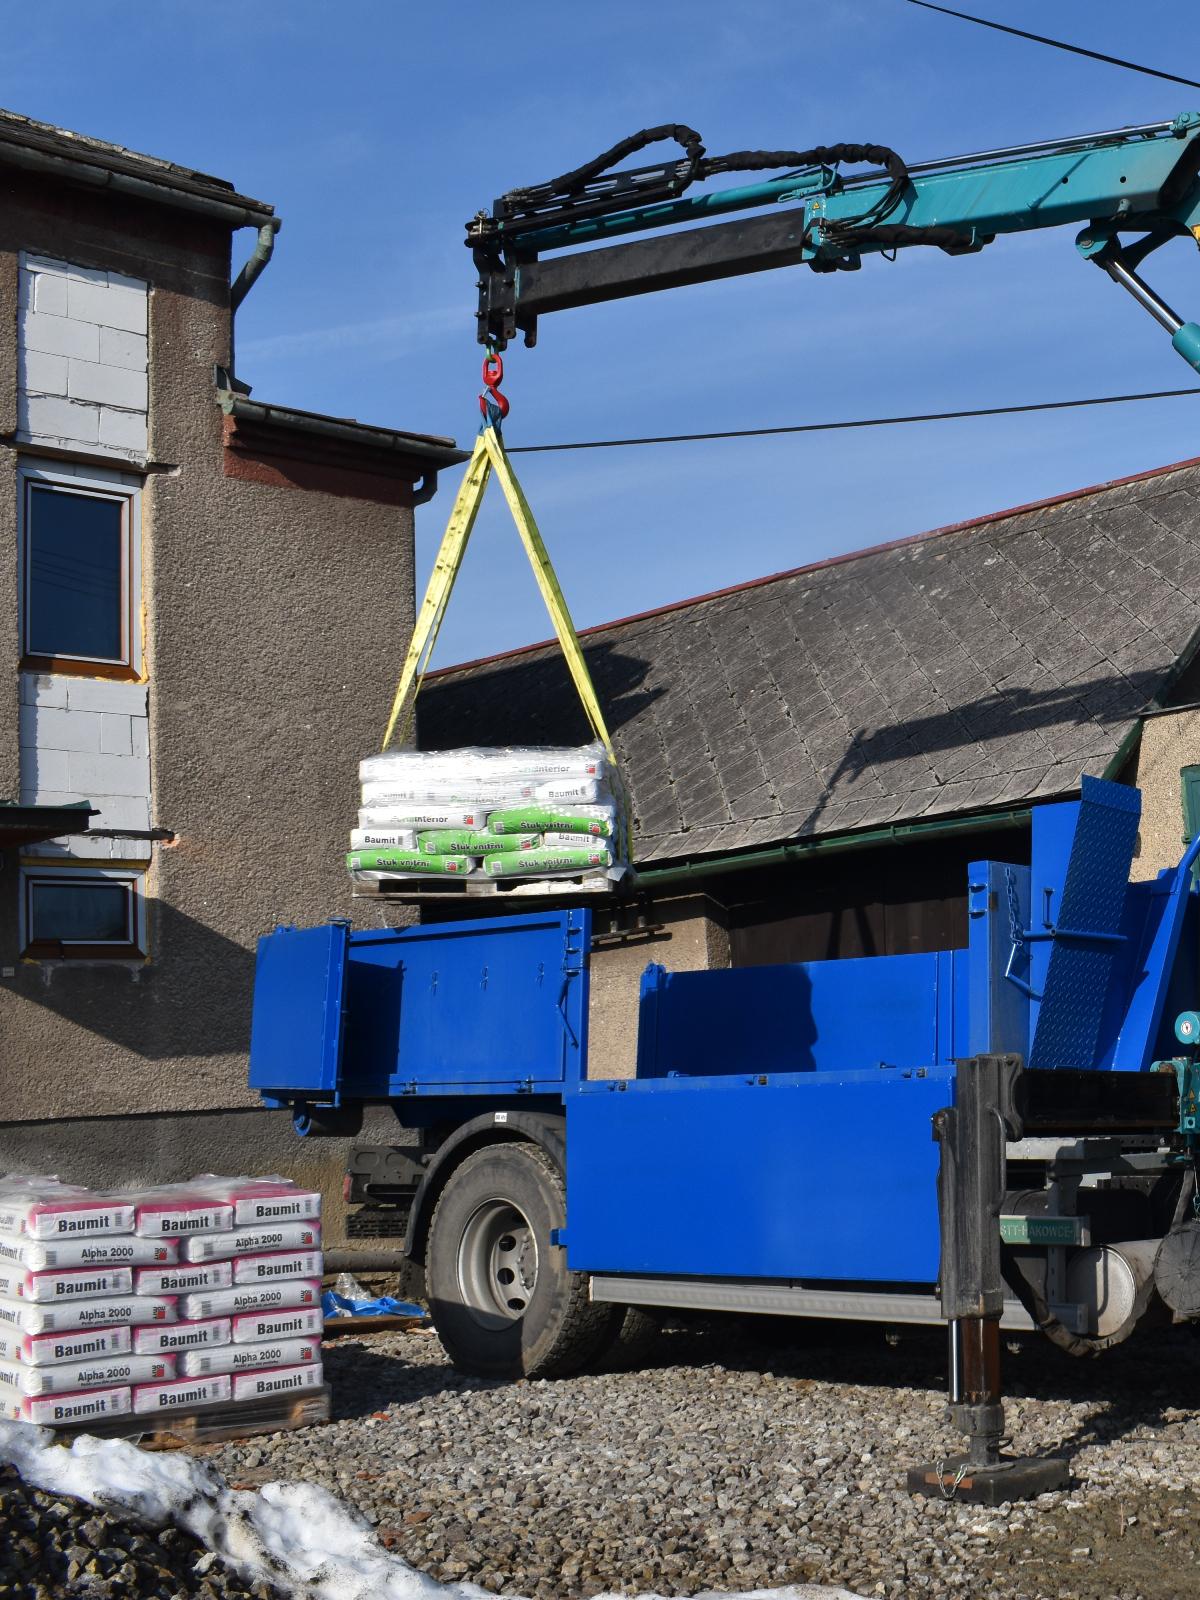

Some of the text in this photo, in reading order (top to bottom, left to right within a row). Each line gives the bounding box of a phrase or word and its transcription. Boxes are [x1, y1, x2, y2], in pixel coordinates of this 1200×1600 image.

[548, 788, 579, 798] Baumit
[364, 835, 395, 844] Baumit
[255, 1201, 302, 1217] Baumit
[58, 1216, 110, 1233] Baumit
[161, 1215, 209, 1231] Baumit
[235, 1237, 259, 1248] Alpha
[261, 1233, 283, 1244] 2000
[81, 1247, 134, 1259] Alpha 2000
[257, 1260, 303, 1277] Baumit
[56, 1278, 107, 1295] Baumit
[160, 1274, 209, 1290] Baumit
[233, 1295, 258, 1306] Alpha
[260, 1292, 282, 1303] 2000
[79, 1307, 132, 1321] Alpha 2000
[257, 1318, 303, 1335] Baumit
[160, 1331, 208, 1348] Baumit
[54, 1340, 106, 1358] Baumit
[233, 1352, 258, 1364] Alpha
[259, 1349, 282, 1361] 2000
[77, 1367, 131, 1382] Alpha 2000
[256, 1375, 303, 1393] Baumit
[159, 1387, 208, 1405] Baumit
[54, 1400, 106, 1419] Baumit
